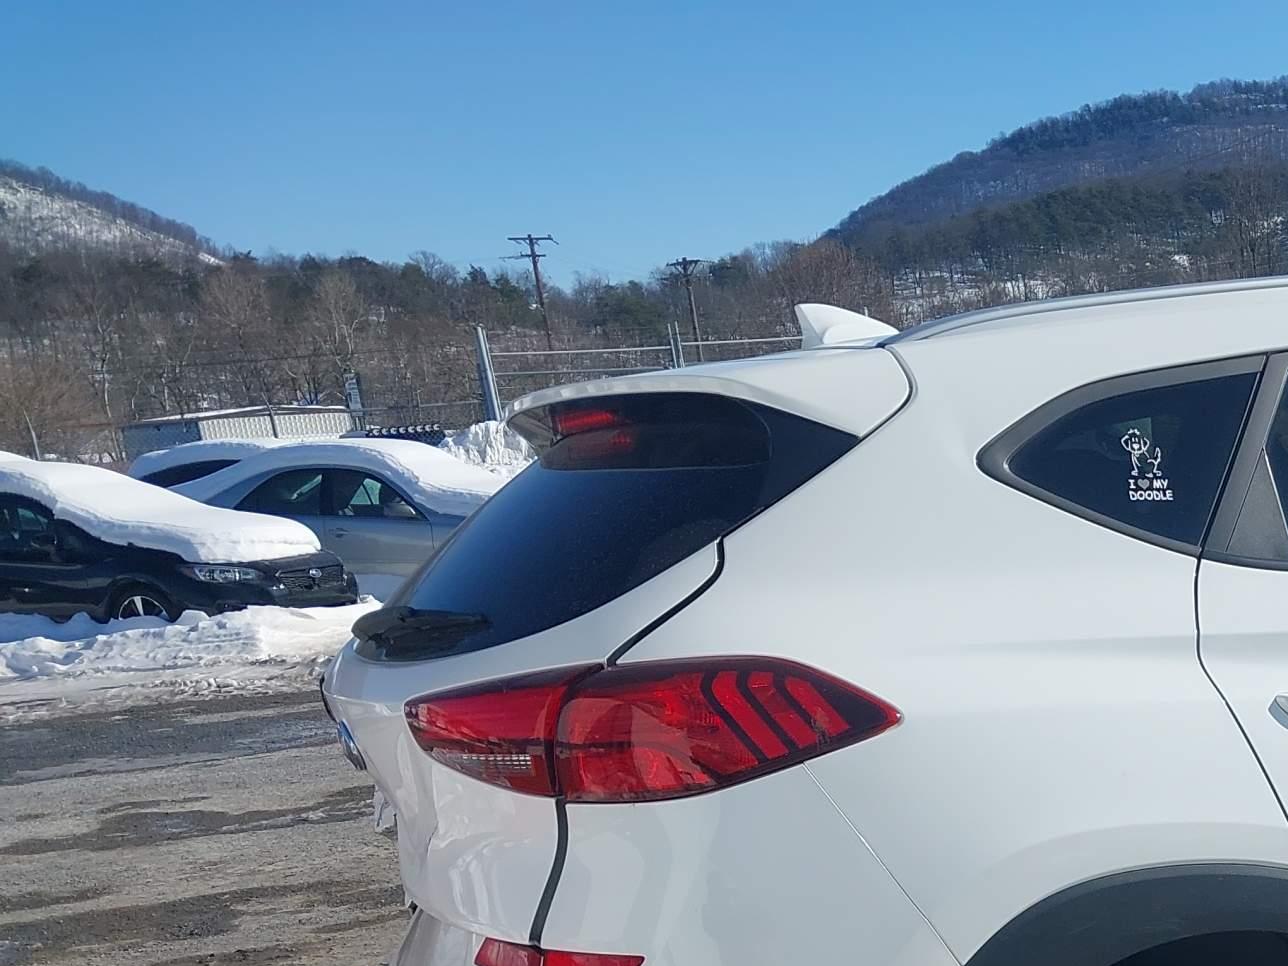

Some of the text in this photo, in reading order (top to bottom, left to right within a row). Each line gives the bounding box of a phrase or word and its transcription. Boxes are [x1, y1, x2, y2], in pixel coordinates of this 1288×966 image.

[1128, 479, 1168, 489] I MY
[1129, 490, 1173, 500] DOODLE
